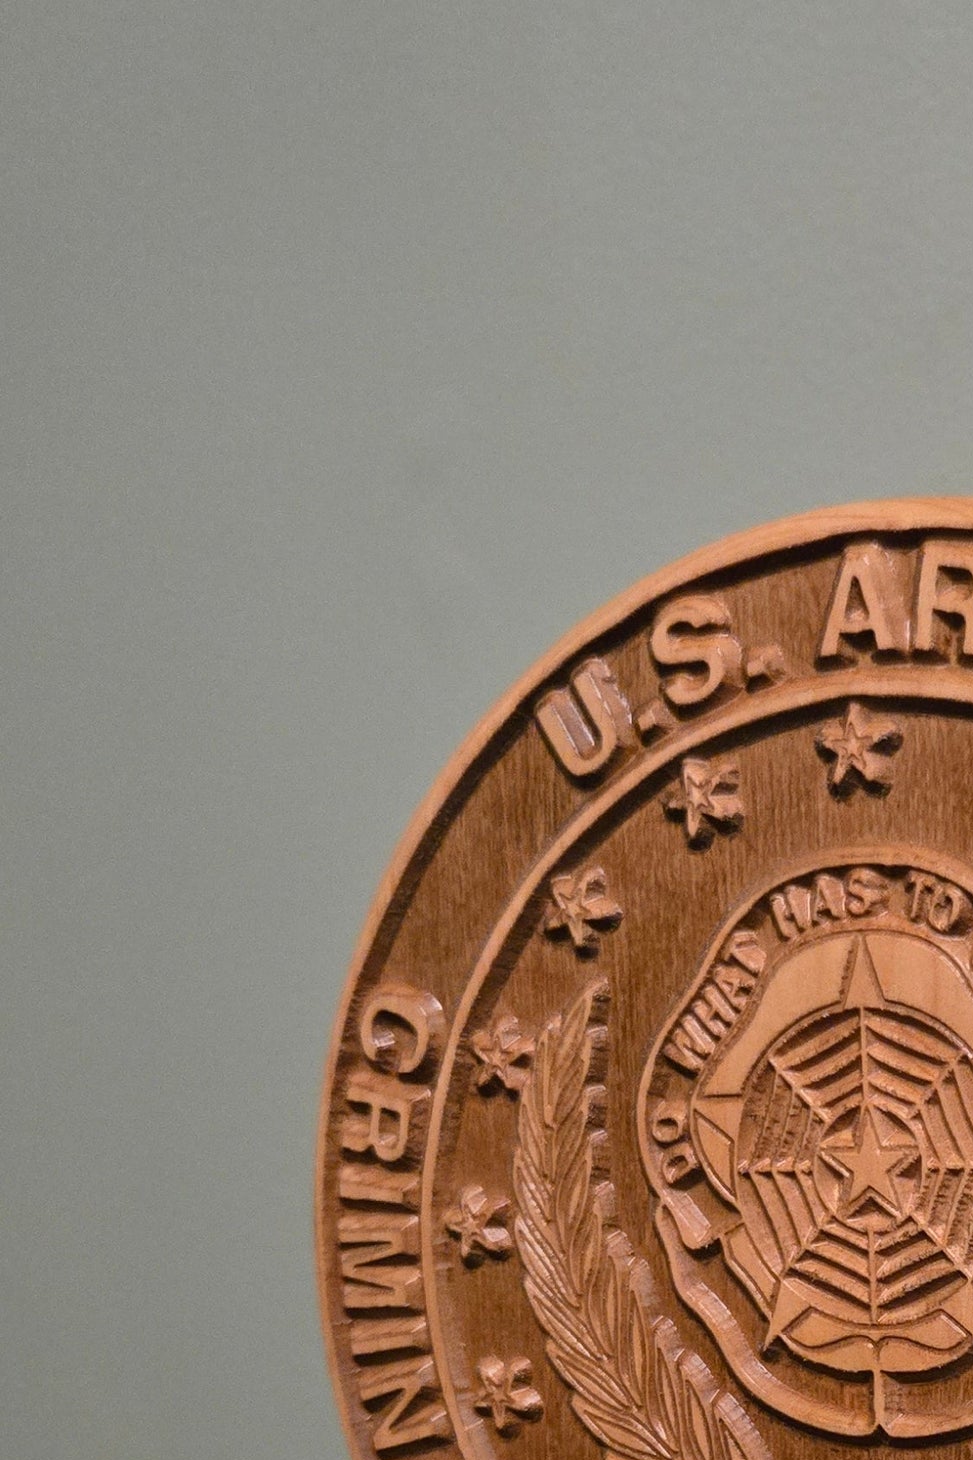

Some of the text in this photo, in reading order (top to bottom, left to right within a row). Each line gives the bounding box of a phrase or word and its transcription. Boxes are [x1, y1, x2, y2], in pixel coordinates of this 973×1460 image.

[535, 597, 790, 778] U.S.
[769, 868, 889, 940] HAS
[903, 868, 972, 935] TO
[663, 931, 766, 1076] WHAT
[651, 1102, 698, 1185] DO
